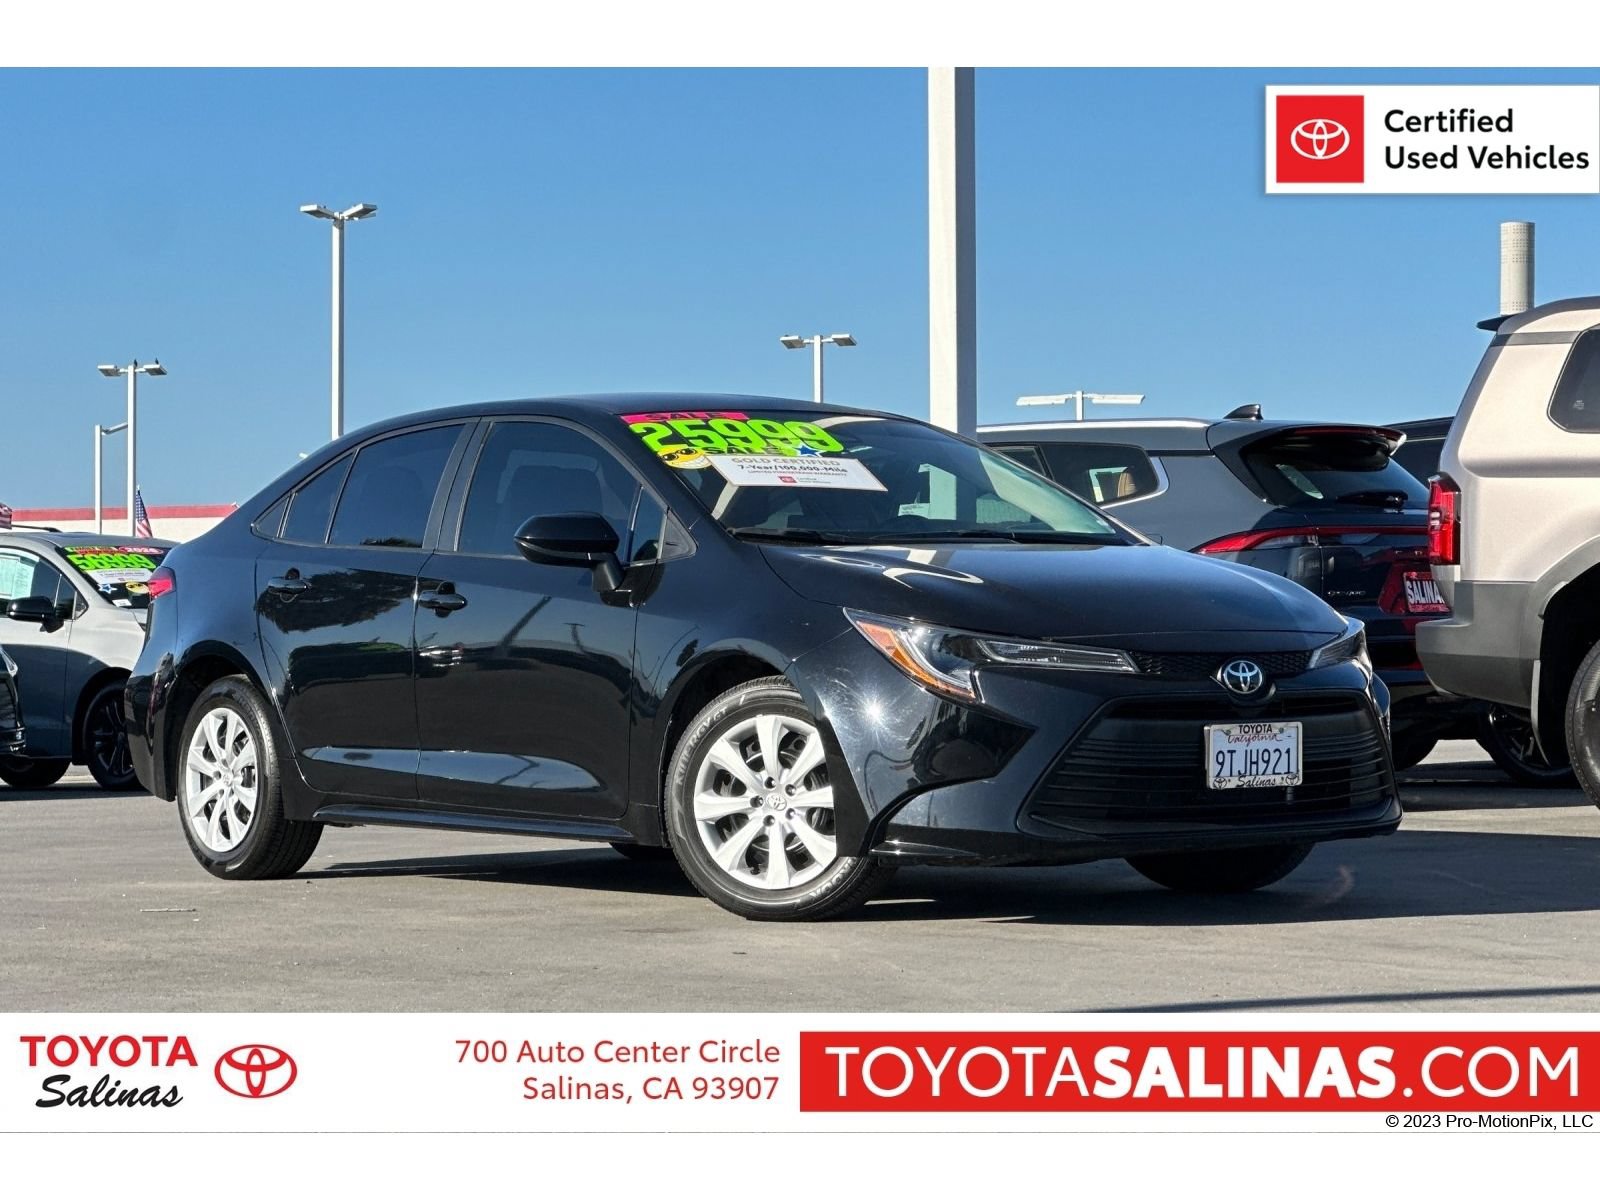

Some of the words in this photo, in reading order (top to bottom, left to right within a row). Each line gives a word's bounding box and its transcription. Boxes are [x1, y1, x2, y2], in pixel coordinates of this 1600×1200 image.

[629, 418, 844, 455] 25999
[702, 446, 780, 454] SALE
[773, 458, 841, 466] CERTIFIED
[67, 553, 157, 569] 56999
[1406, 580, 1445, 604] SALINA
[1239, 724, 1273, 734] TOYOTA
[1228, 733, 1283, 747] California
[1215, 747, 1294, 777] 9TJH921
[1236, 775, 1276, 788] Salinas
